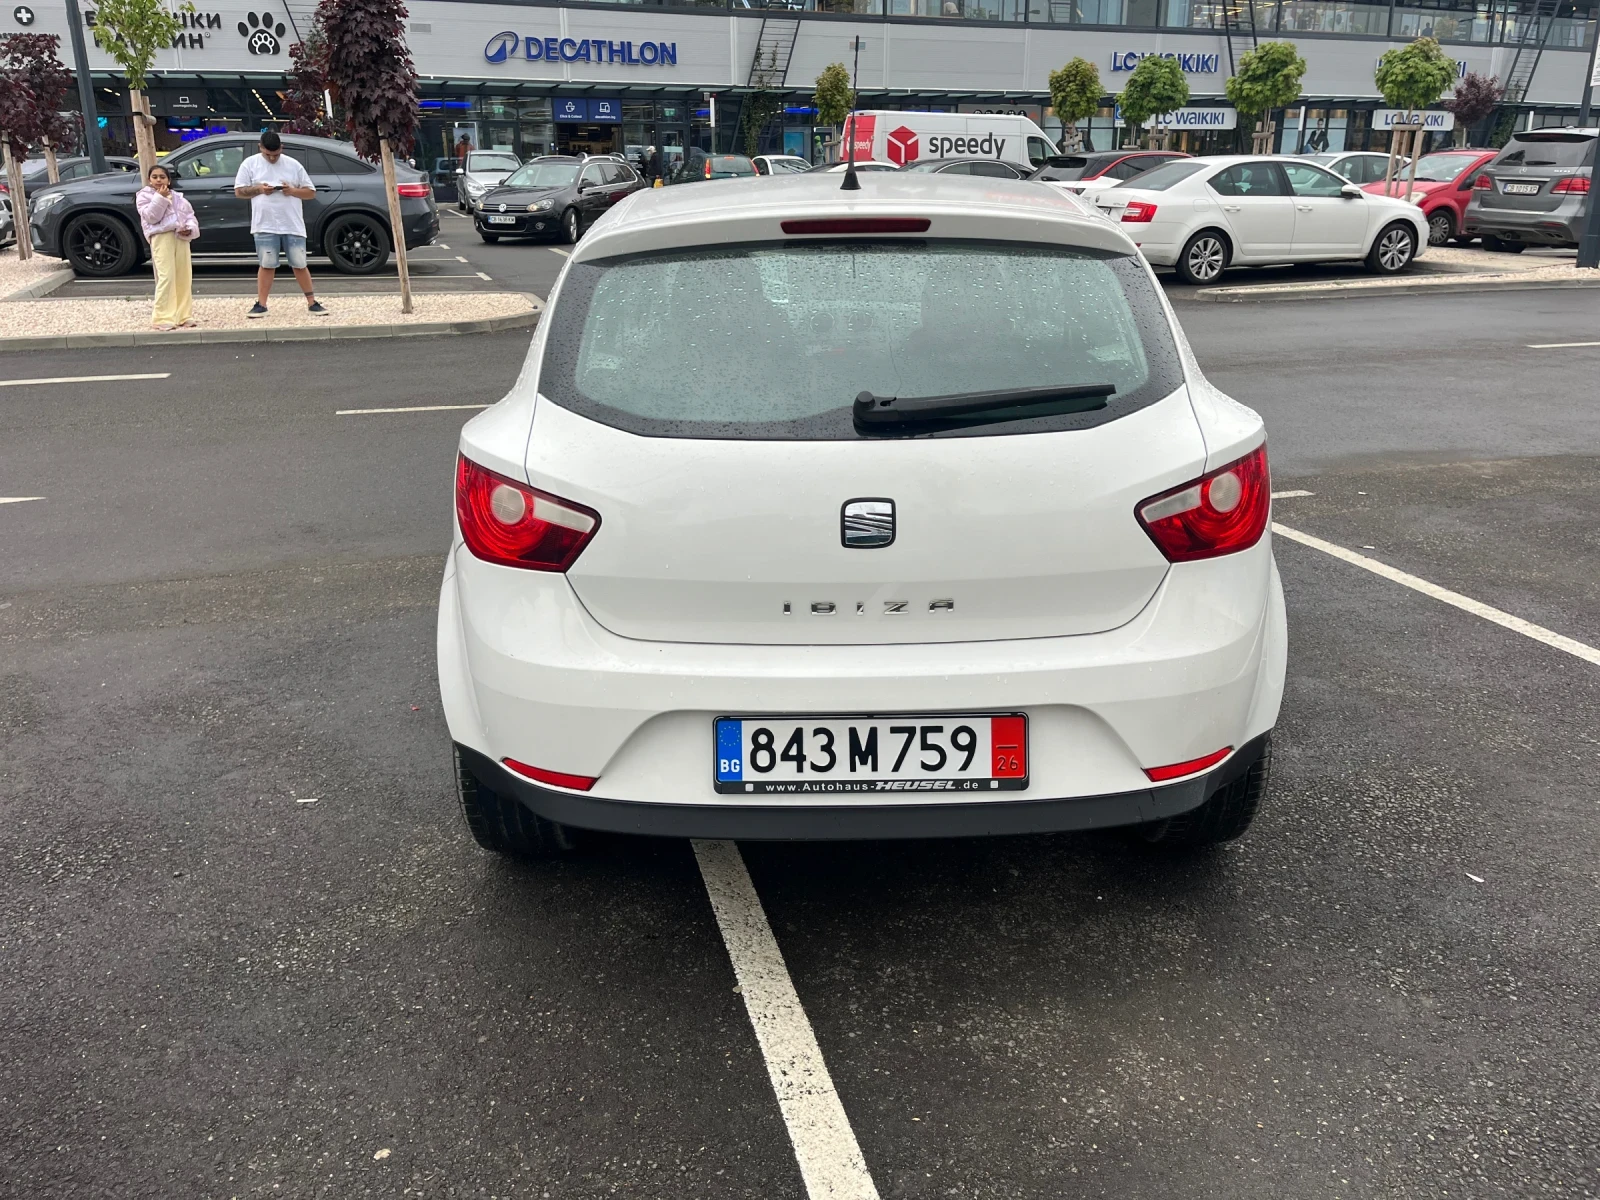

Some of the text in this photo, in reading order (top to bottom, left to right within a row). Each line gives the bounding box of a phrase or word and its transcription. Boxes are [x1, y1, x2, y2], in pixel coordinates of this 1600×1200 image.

[525, 36, 677, 65] DECATHLON
[1112, 51, 1137, 71] LC
[854, 138, 871, 152] speedy
[929, 131, 1006, 160] speedy
[783, 598, 954, 615] IBIZA
[749, 725, 978, 773] 843 M 759
[720, 759, 741, 773] BG
[996, 755, 1019, 771] 26
